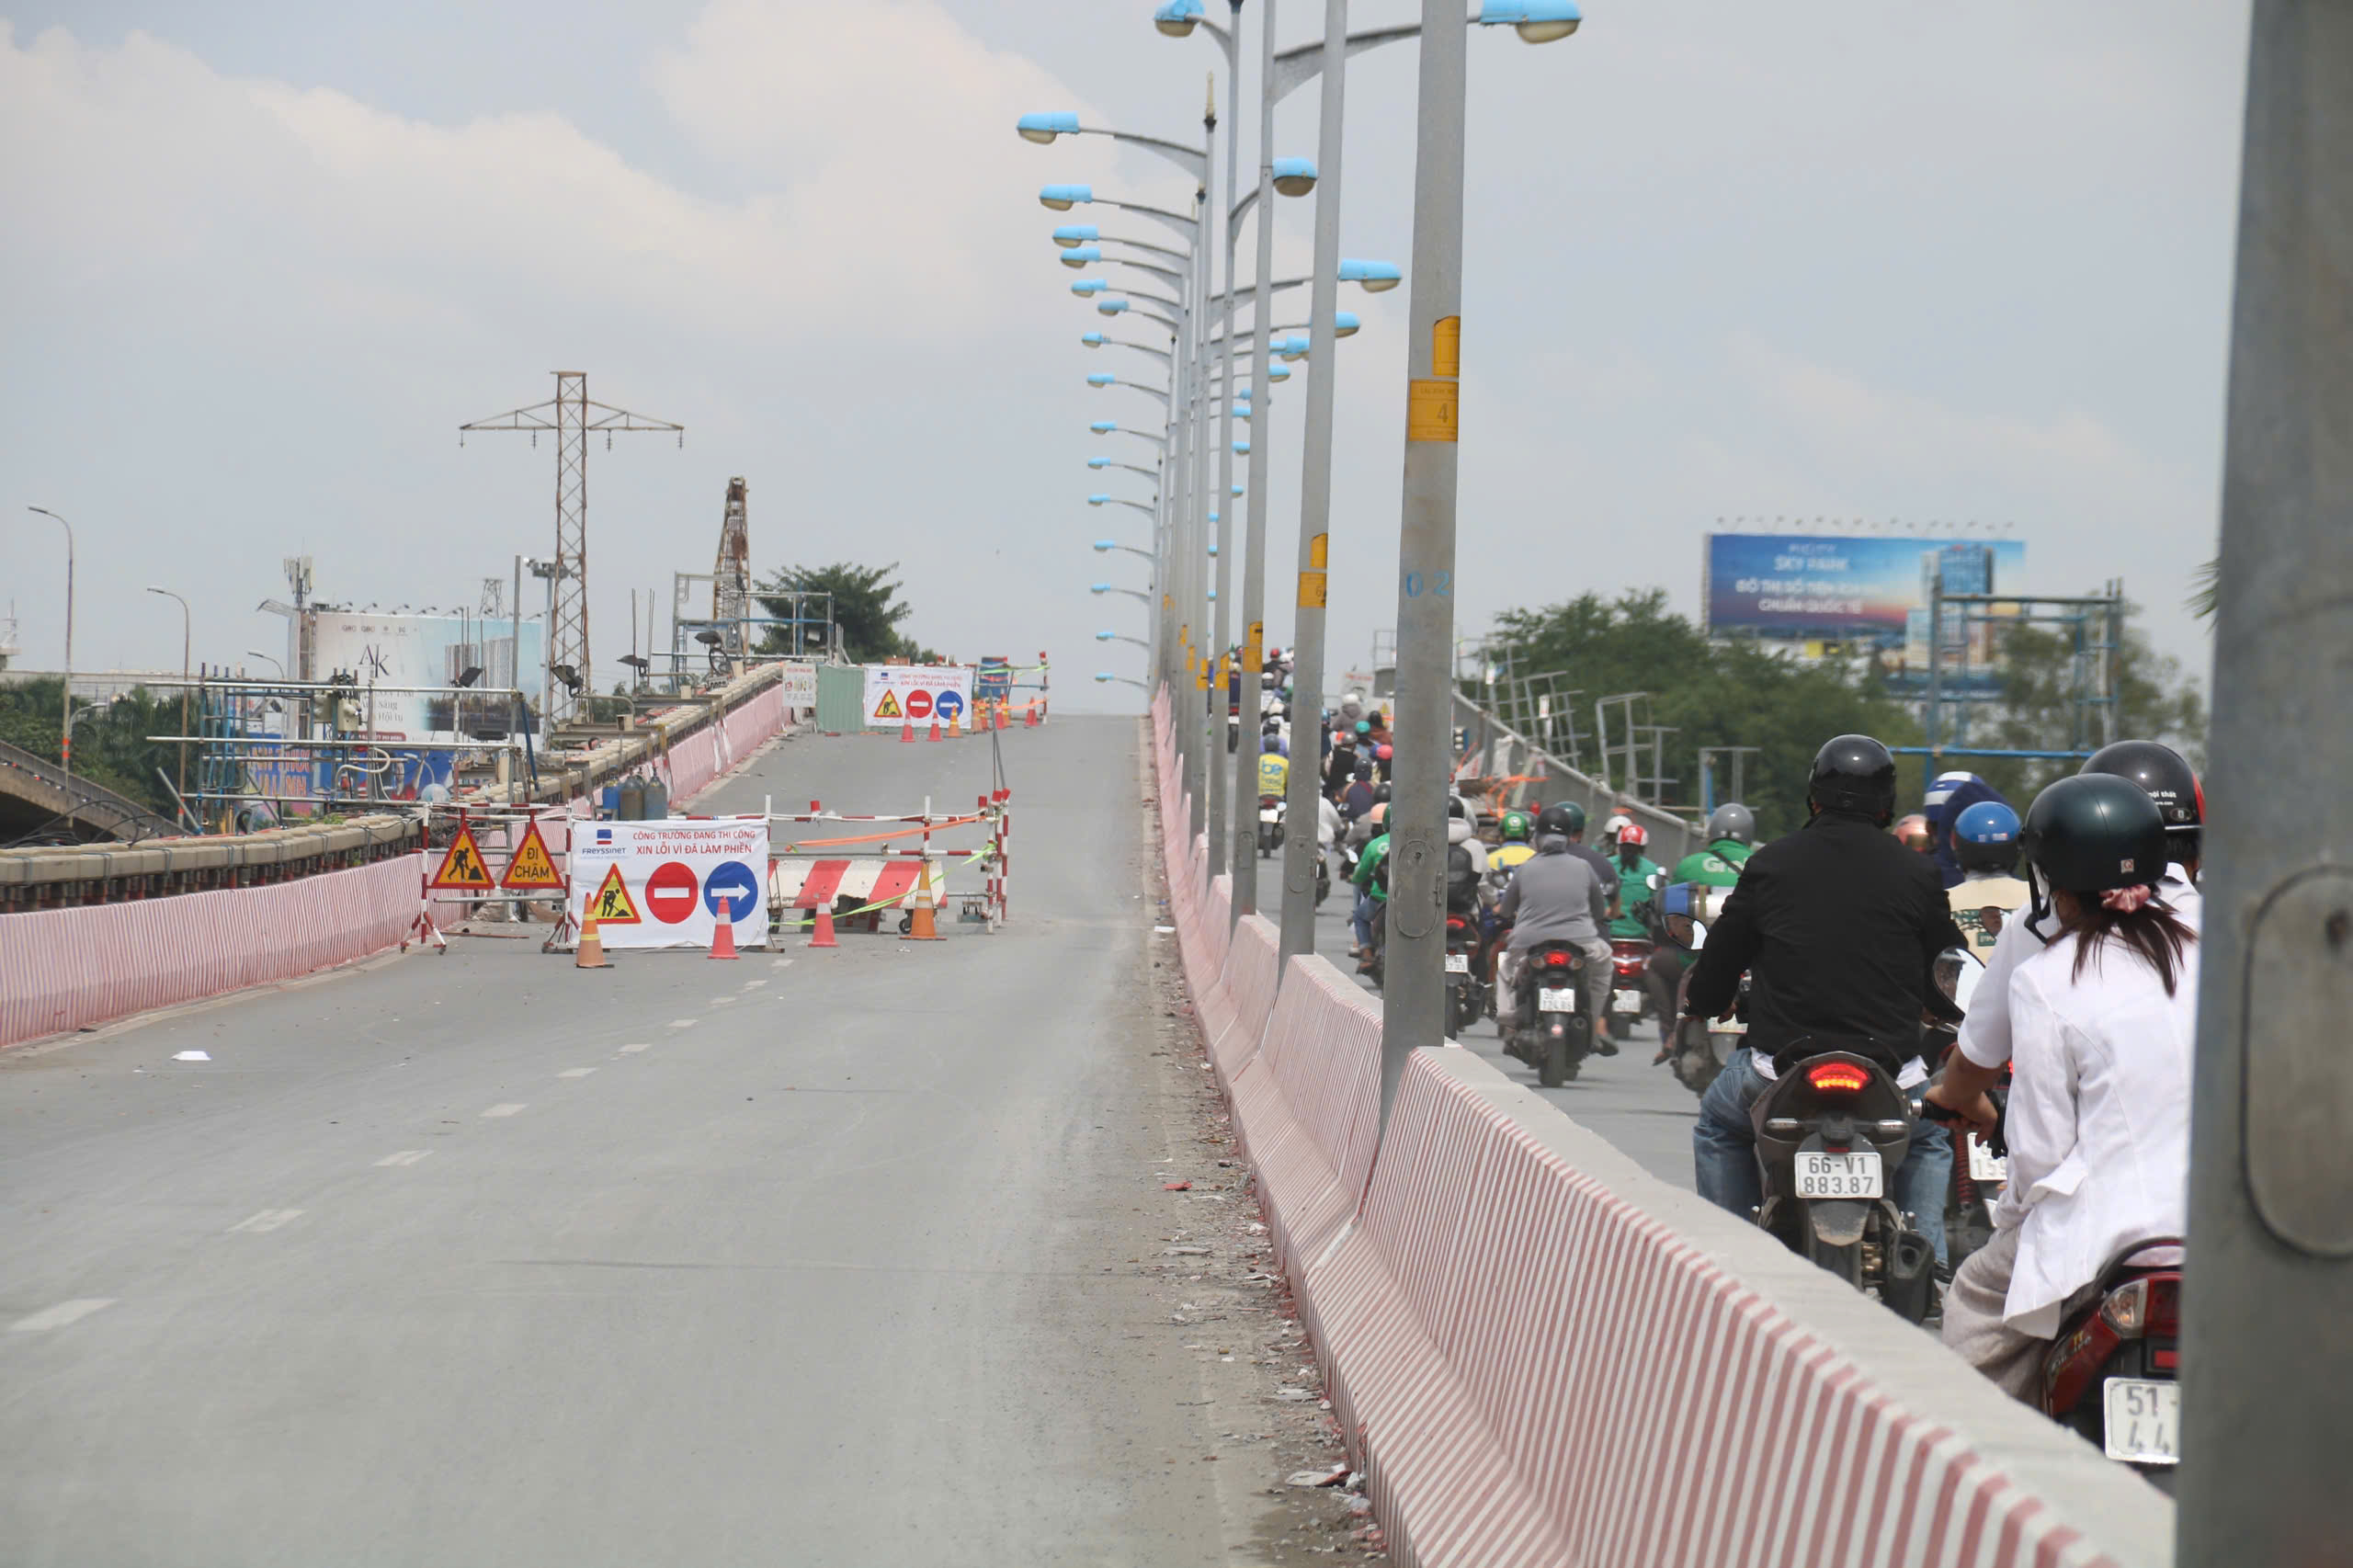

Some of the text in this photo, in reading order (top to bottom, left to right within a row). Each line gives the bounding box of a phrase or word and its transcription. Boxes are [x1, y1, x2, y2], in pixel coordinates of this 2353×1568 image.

[1437, 403, 1449, 423] 4
[633, 829, 756, 840] CÔNG TRƯỜNG ĐANG THI CÔNG
[527, 847, 539, 860] ĐI
[636, 841, 752, 855] XIN LỖI VÌ ĐÃ LÀM PHIỀN
[515, 863, 550, 881] CHẬM
[1809, 1156, 1867, 1175] 66-V1
[1803, 1176, 1874, 1195] 883.87
[2126, 1385, 2178, 1417] 51-
[2128, 1421, 2171, 1455] 44
